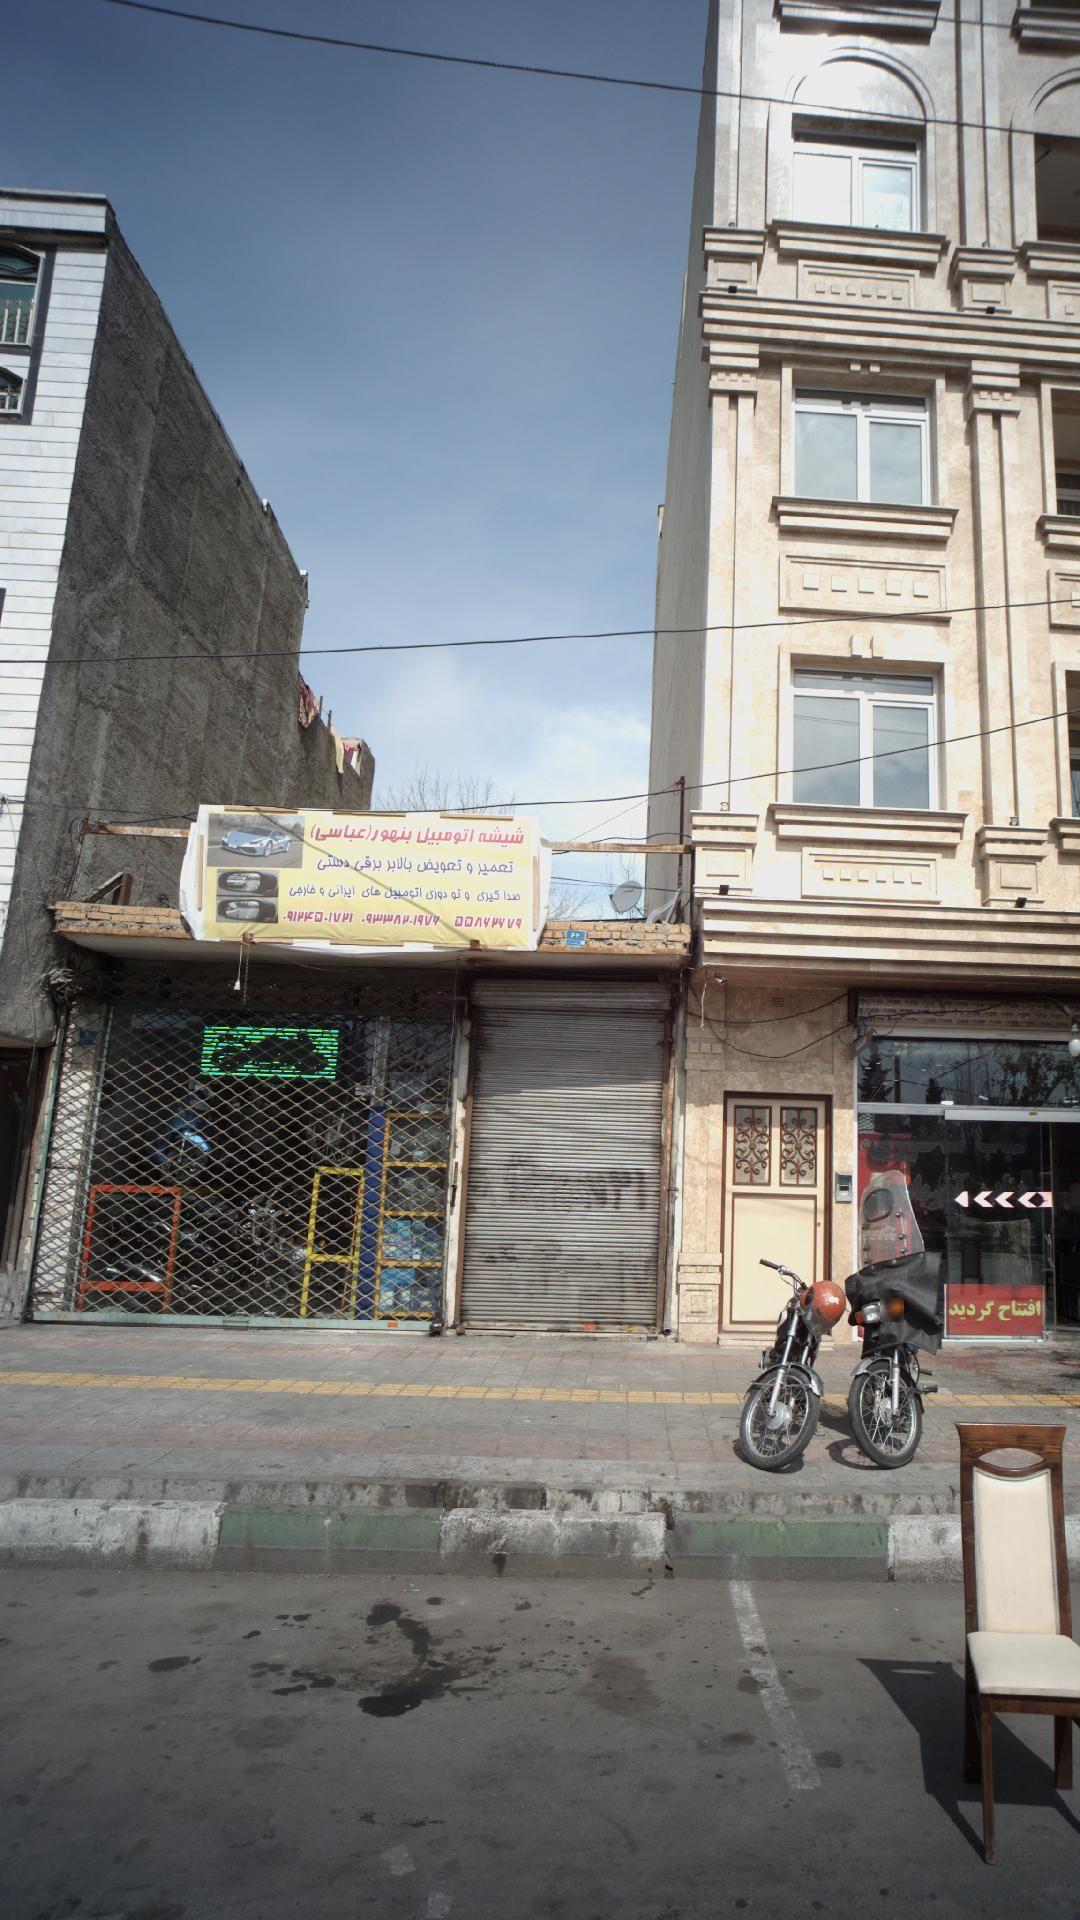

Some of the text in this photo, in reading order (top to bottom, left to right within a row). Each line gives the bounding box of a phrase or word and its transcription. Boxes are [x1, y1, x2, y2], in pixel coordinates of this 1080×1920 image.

[416, 827, 475, 845] اتومبیل
[478, 827, 524, 847] شیشه
[317, 854, 514, 876] تعمیر و تعویض بالابر برقی دستی
[289, 884, 316, 896] خارجی
[319, 886, 325, 896] و
[328, 884, 355, 898] ایرانی
[362, 886, 381, 898] های
[385, 886, 422, 900] اتومبیل
[451, 888, 461, 902] تو
[464, 891, 470, 902] و
[503, 890, 521, 901] صدا
[949, 1299, 1041, 1322] افتتاح گردید
